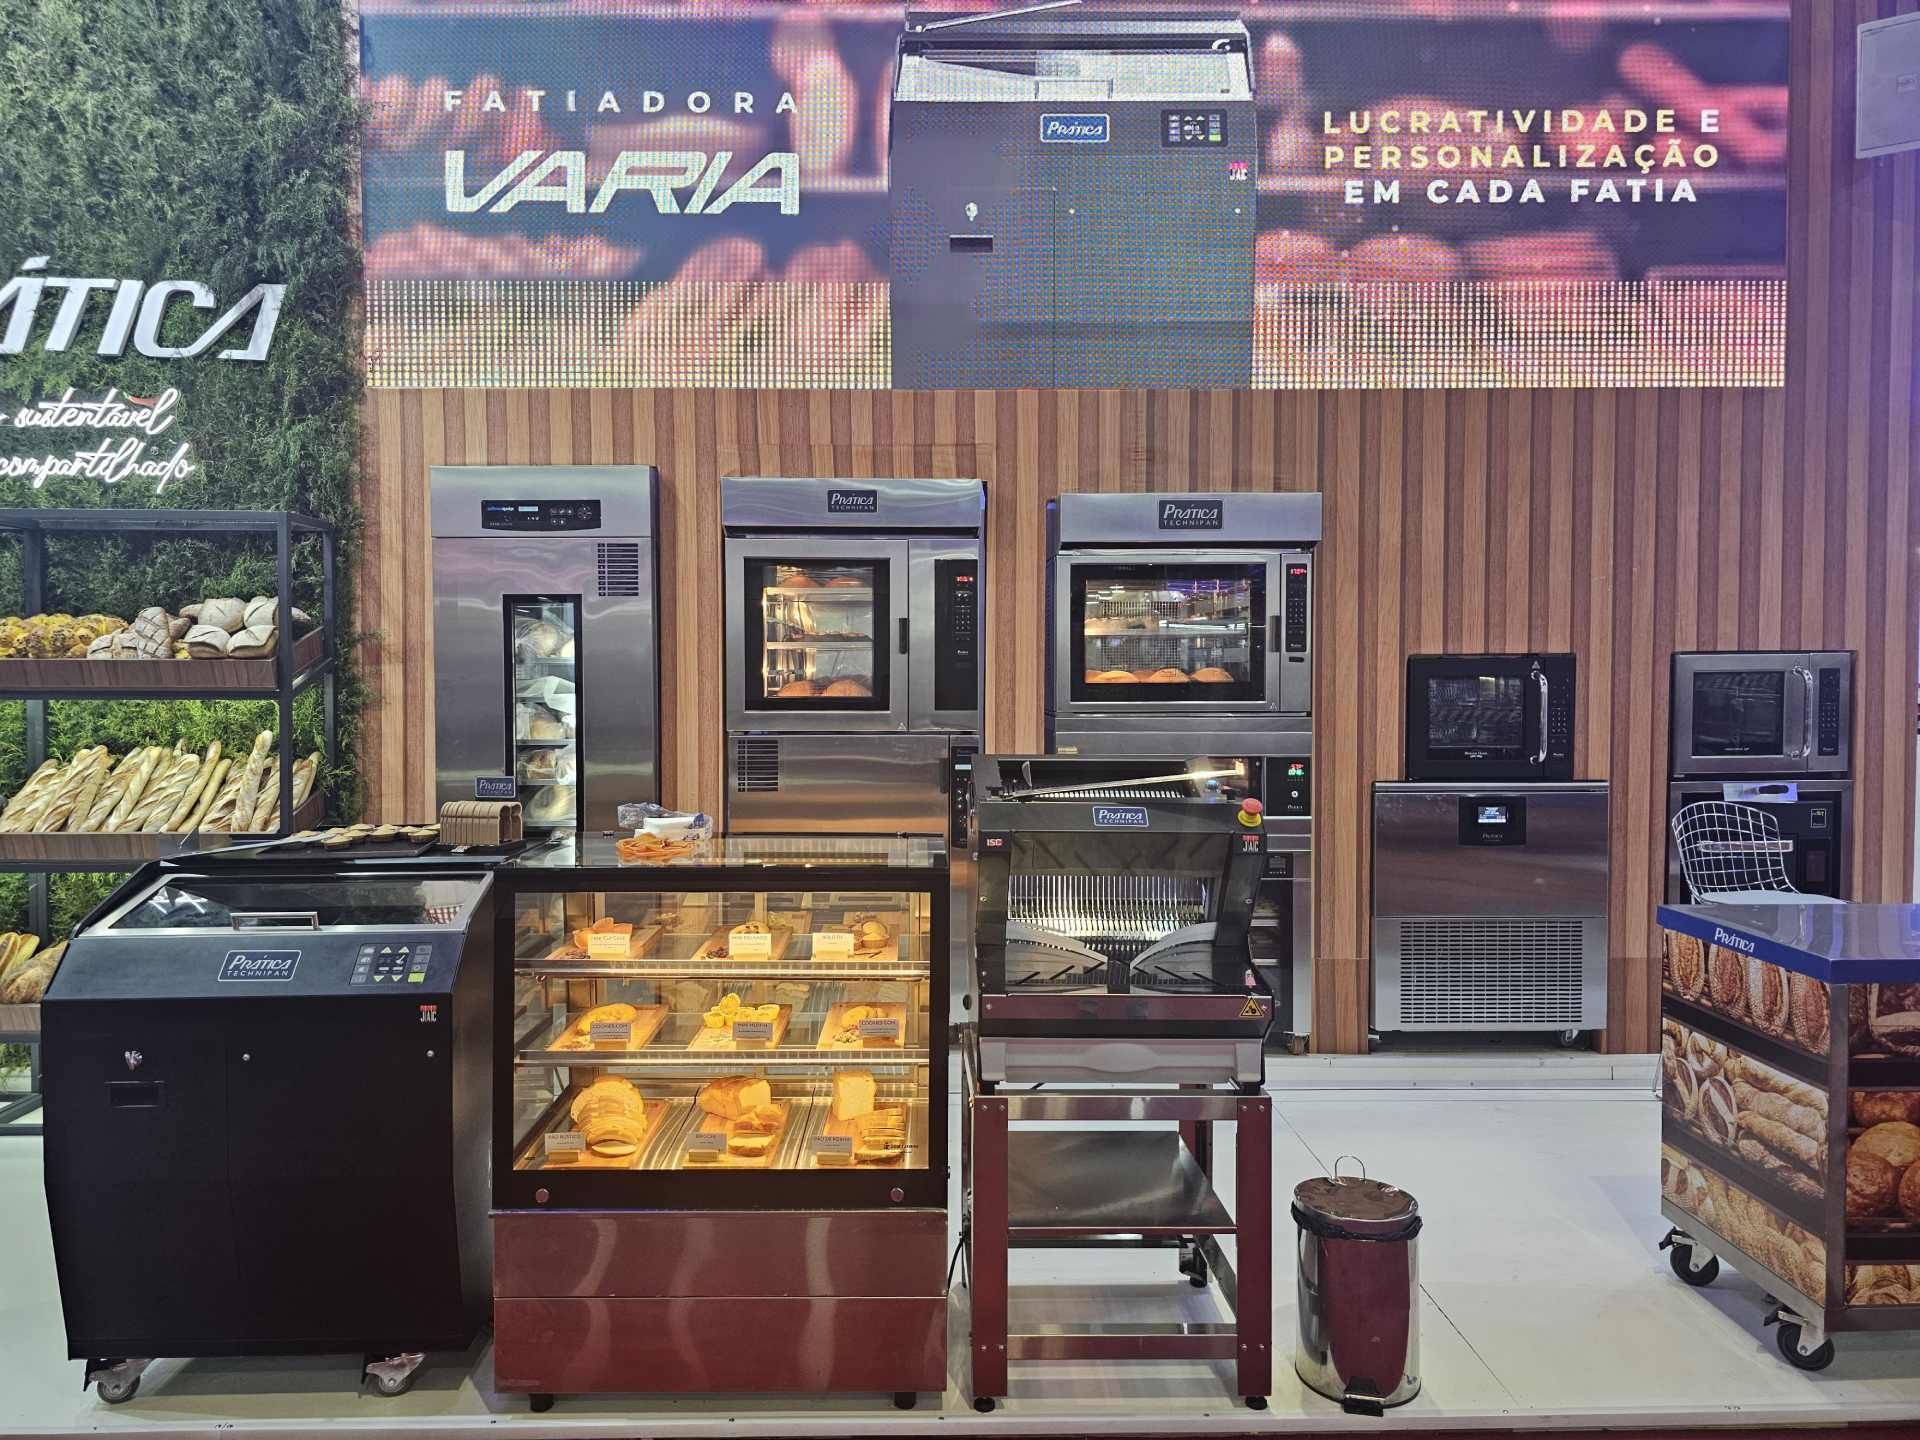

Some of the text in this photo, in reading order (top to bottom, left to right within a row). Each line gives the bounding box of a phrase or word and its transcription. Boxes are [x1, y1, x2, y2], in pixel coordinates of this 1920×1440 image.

[444, 89, 798, 114] FATIADORA
[1323, 109, 1720, 134] LUCRATIVIDADE E
[1324, 138, 1719, 174] PERSONALIZAÇÃO
[445, 150, 800, 215] VARIA
[1344, 178, 1697, 204] EM CADA FATIA
[14, 387, 179, 435] sustentável
[0, 437, 196, 495] compartilhado
[228, 954, 292, 970] PRÁTICA
